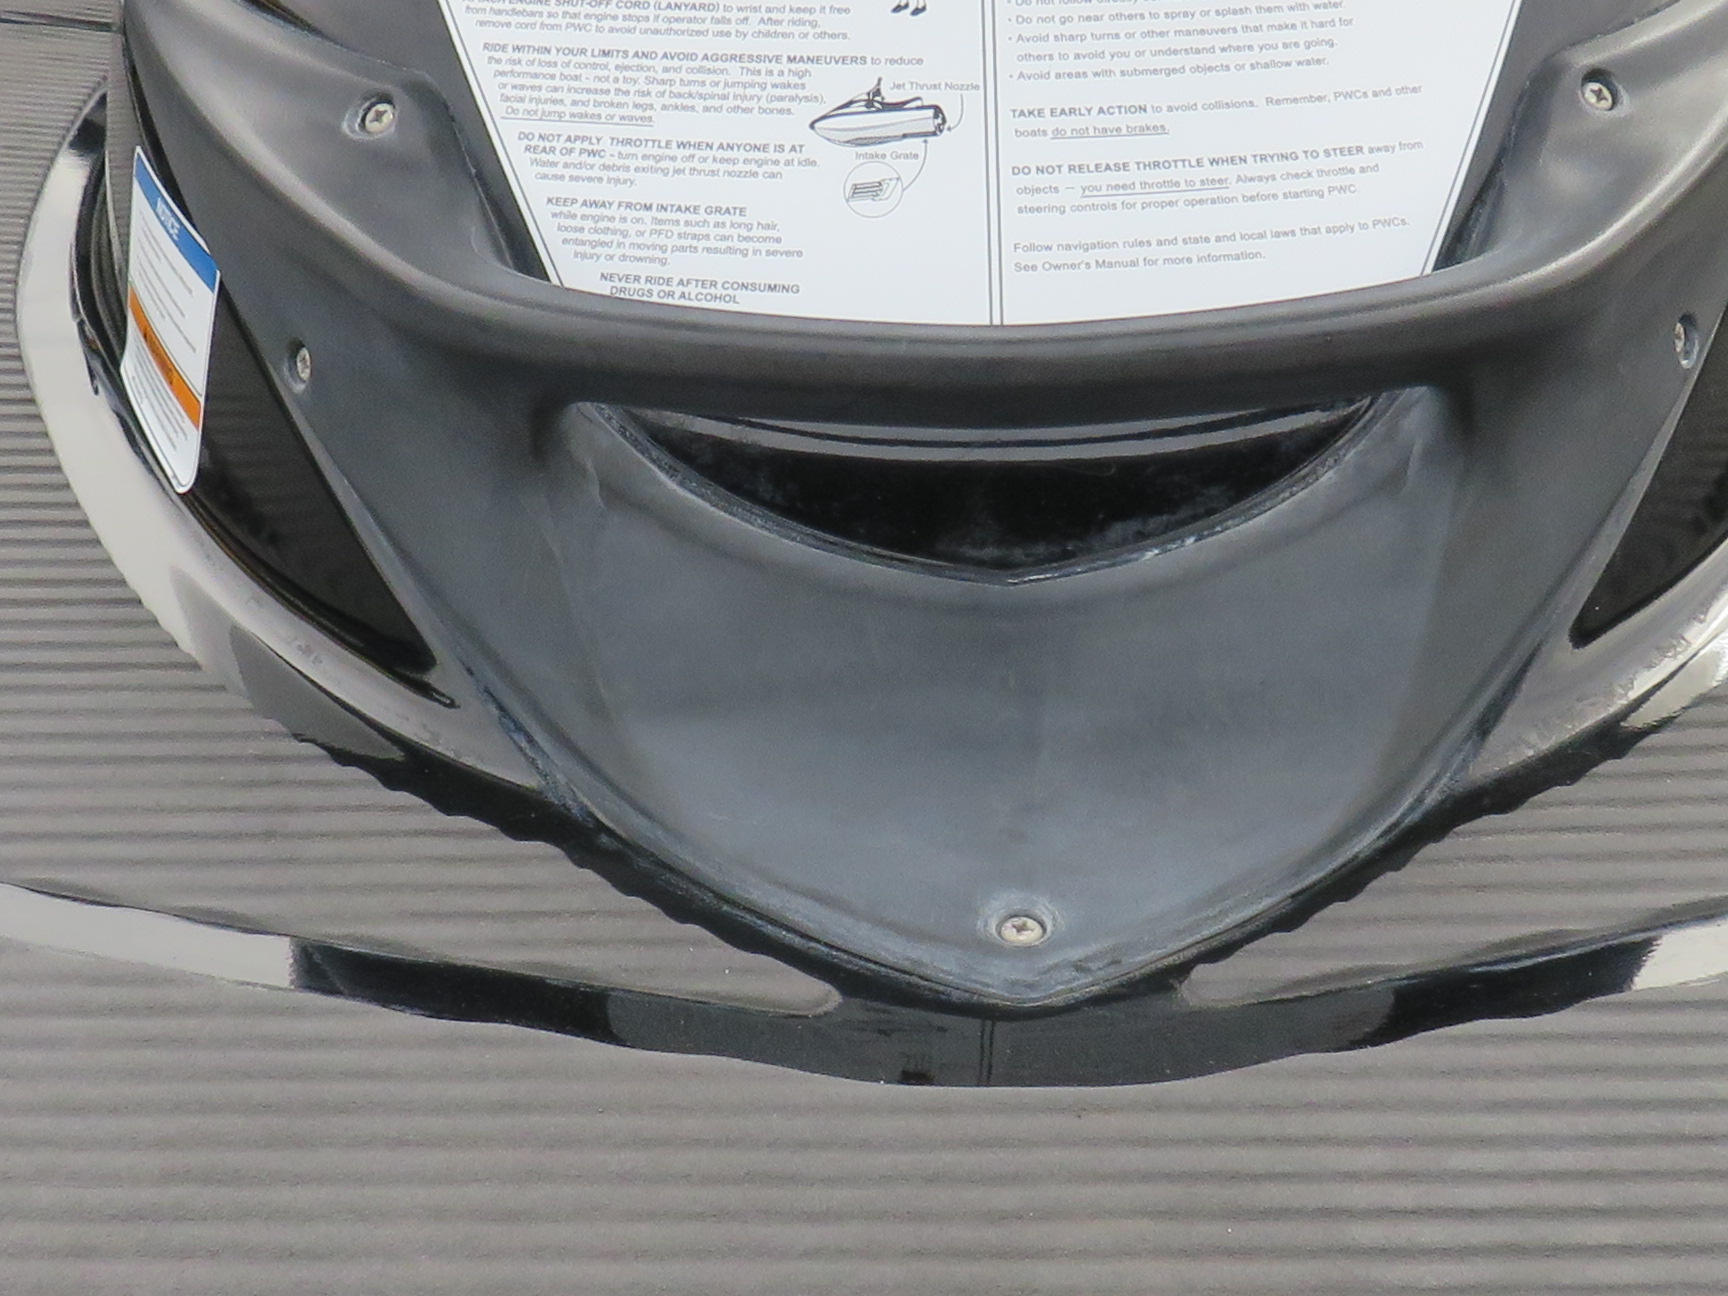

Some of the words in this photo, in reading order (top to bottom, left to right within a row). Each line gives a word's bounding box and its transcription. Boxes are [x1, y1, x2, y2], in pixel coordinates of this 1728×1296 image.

[615, 0, 650, 10] CORD
[653, 0, 720, 12] (LANYARD)
[482, 42, 508, 53] RIDE
[511, 44, 552, 55] WITHIN
[554, 46, 588, 57] YOUR
[590, 48, 629, 59] LIMITS
[631, 50, 658, 60] AND
[660, 51, 698, 61] AVOID
[700, 52, 783, 64] AGGRESSIVE
[786, 54, 867, 65] MANEUVERS
[870, 56, 881, 65] to
[884, 56, 923, 66] reduce
[889, 81, 906, 90] Jet
[909, 81, 942, 90] Thrust
[944, 82, 980, 91] Nozzle
[1010, 108, 1045, 118] TAKE
[1049, 106, 1093, 117] EARLY
[1096, 104, 1147, 115] ACTION
[517, 130, 535, 142] DO
[537, 132, 562, 143] NOT
[564, 134, 602, 145] APPLY
[610, 136, 672, 149] THROTTLE
[676, 140, 714, 151] WHEN
[716, 142, 770, 152] ANYONE
[773, 143, 785, 153] IS
[788, 144, 804, 153] AT
[524, 144, 556, 155] REAR
[559, 146, 576, 157] OF
[578, 147, 606, 158] PWC
[855, 151, 887, 160] Intake
[890, 152, 919, 160] Grate
[1011, 165, 1031, 176] DO
[1035, 164, 1062, 175] NOT
[1067, 161, 1130, 174] RELEASE
[1134, 157, 1204, 171] THROTTLE
[1208, 155, 1247, 167] WHEN
[1251, 151, 1299, 163] TRYING
[1302, 149, 1319, 160] TO
[1322, 145, 1364, 158] STEER
[1368, 144, 1395, 155] away
[1398, 139, 1422, 151] from
[546, 196, 578, 207] KEEP
[580, 198, 614, 209] AWAY
[617, 201, 653, 212] FROM
[656, 203, 701, 214] INTAKE
[704, 205, 747, 217] GRATE
[599, 272, 641, 284] NEVER
[644, 275, 673, 286] RIDE
[676, 277, 718, 289] AFTER
[721, 280, 800, 294] CONSUMING
[610, 286, 653, 299] DRUGS
[656, 289, 675, 299] OR
[678, 290, 740, 304] ALCOHOL
